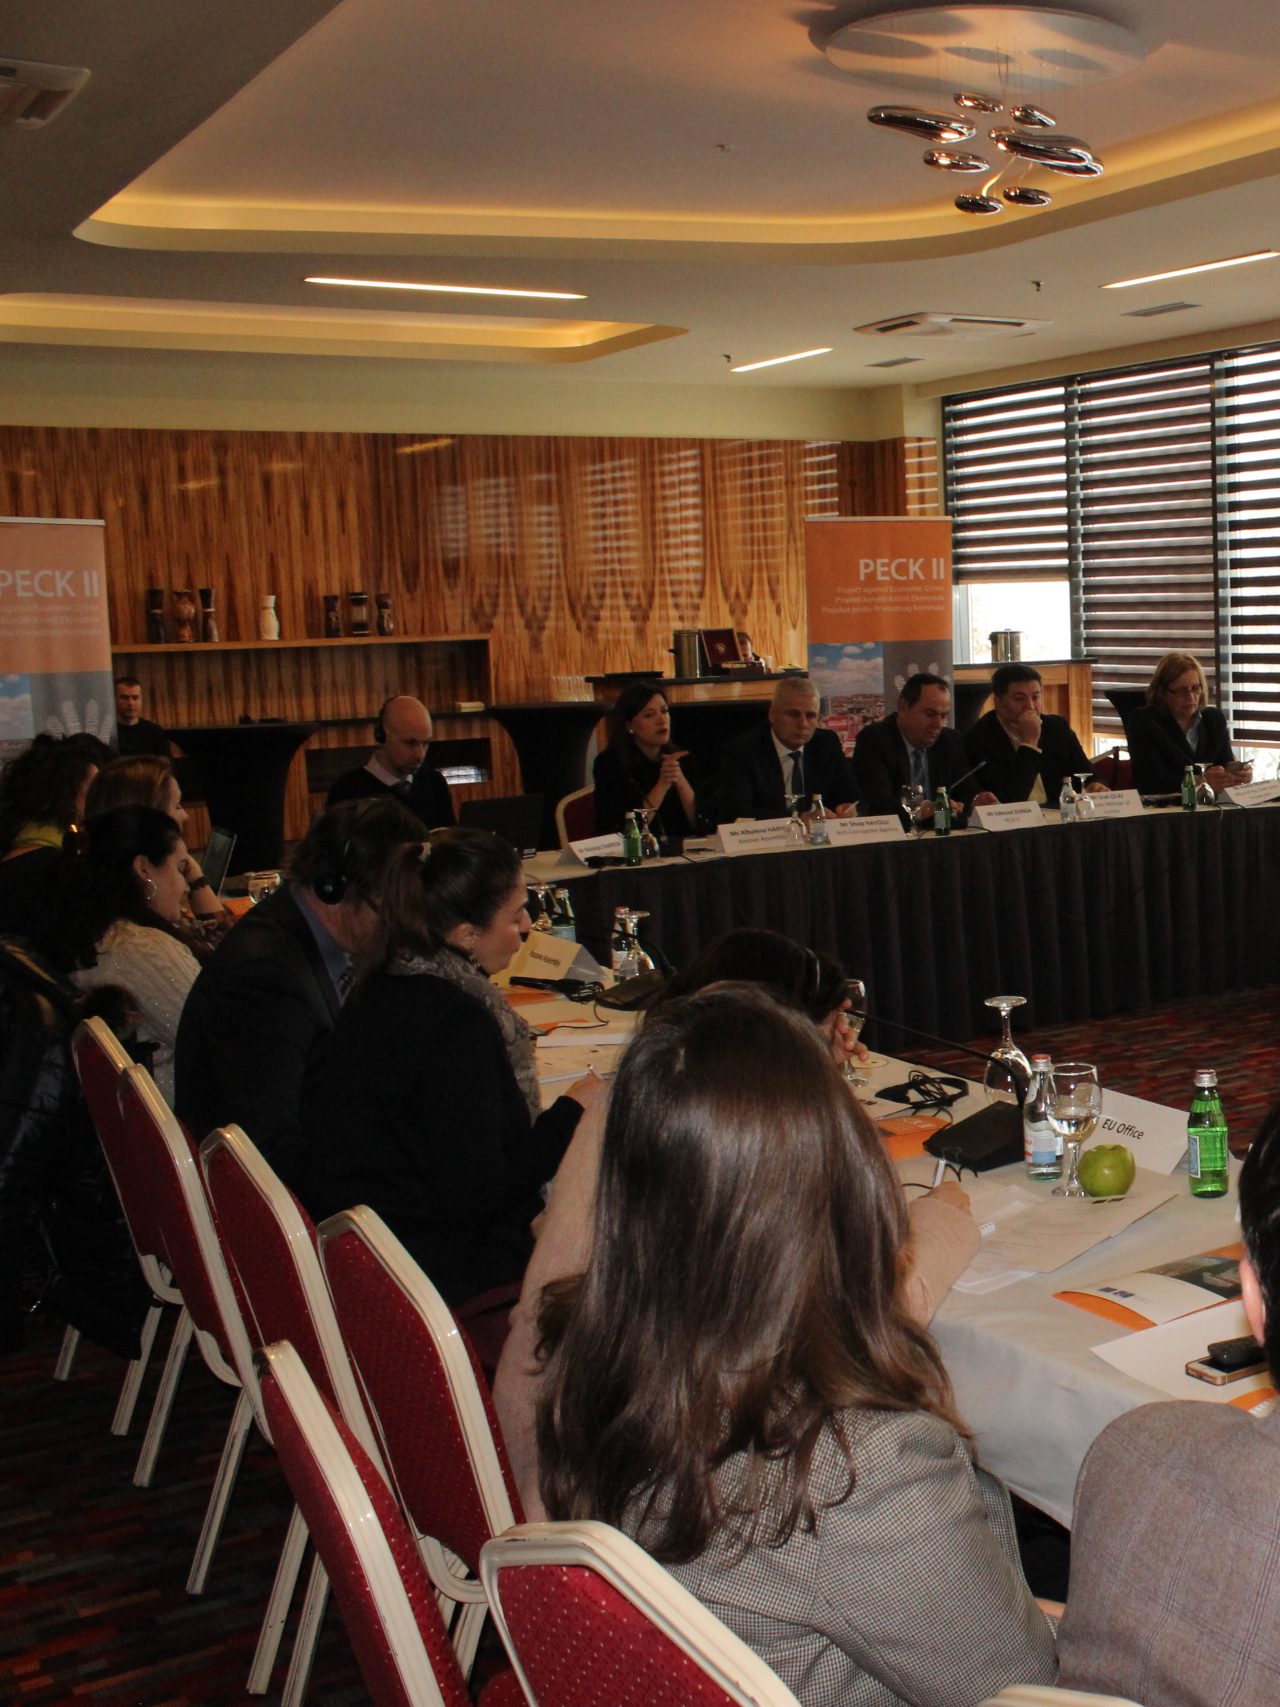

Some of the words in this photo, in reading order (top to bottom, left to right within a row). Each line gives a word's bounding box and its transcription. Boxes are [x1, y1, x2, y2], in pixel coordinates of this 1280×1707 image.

[859, 558, 926, 581] PECK
[932, 557, 945, 580] II
[0, 570, 76, 597] PECK
[83, 570, 99, 597] II
[1102, 1118, 1118, 1131] EU
[1116, 1123, 1144, 1140] Office
